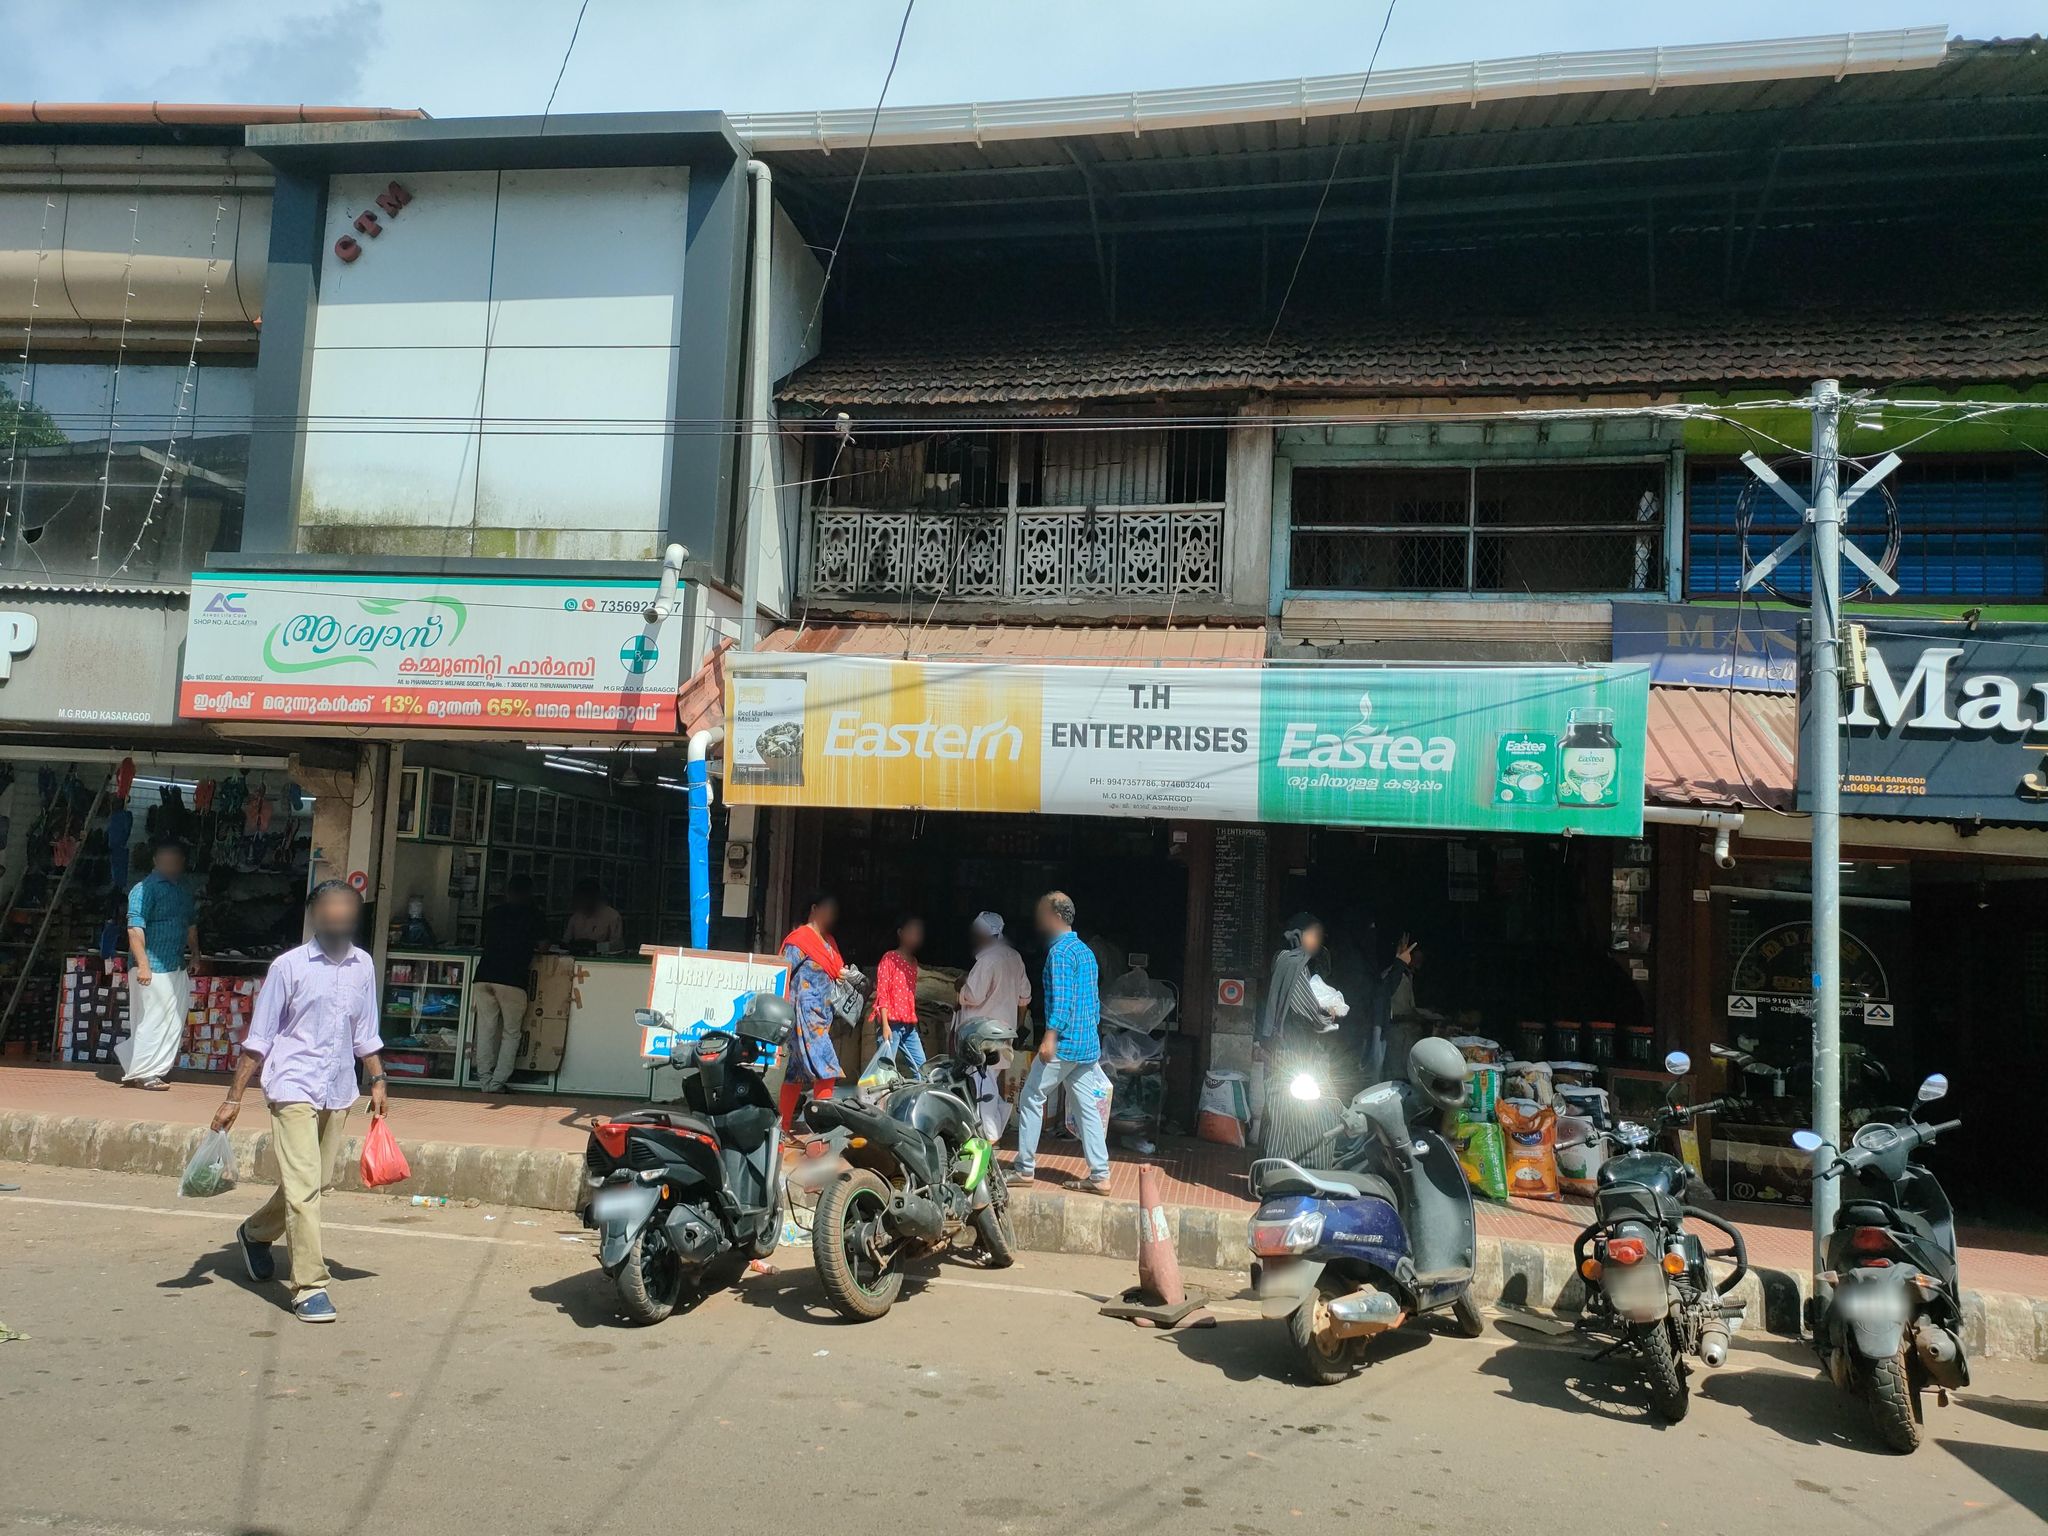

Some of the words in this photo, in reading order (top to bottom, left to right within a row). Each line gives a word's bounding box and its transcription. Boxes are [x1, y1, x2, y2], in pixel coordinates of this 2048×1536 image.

[600, 600, 682, 613] 73569237
[283, 615, 444, 654] ആശ്വാസ്
[507, 655, 596, 677] ഫാർമസി
[193, 690, 256, 713] ഇംഗ്ലീഷ്
[381, 695, 423, 715] 13%
[427, 699, 481, 718] മുതൽ
[487, 698, 532, 717] 65%
[535, 703, 571, 718] വരെ
[1128, 684, 1171, 710] T.H
[99, 711, 151, 722] KASARAGOD
[823, 711, 1023, 760] Eastern
[1051, 723, 1248, 753] ENTERPRISES
[1277, 722, 1456, 771] Eastea
[1505, 740, 1547, 752] Eastea
[1089, 777, 1104, 786] PH:
[1849, 774, 1872, 782] ROAD
[1873, 776, 1926, 784] KASARAGOD
[1119, 793, 1145, 801] ROAD,
[1146, 794, 1193, 803] KASARGOD
[1885, 784, 1926, 795] 222190
